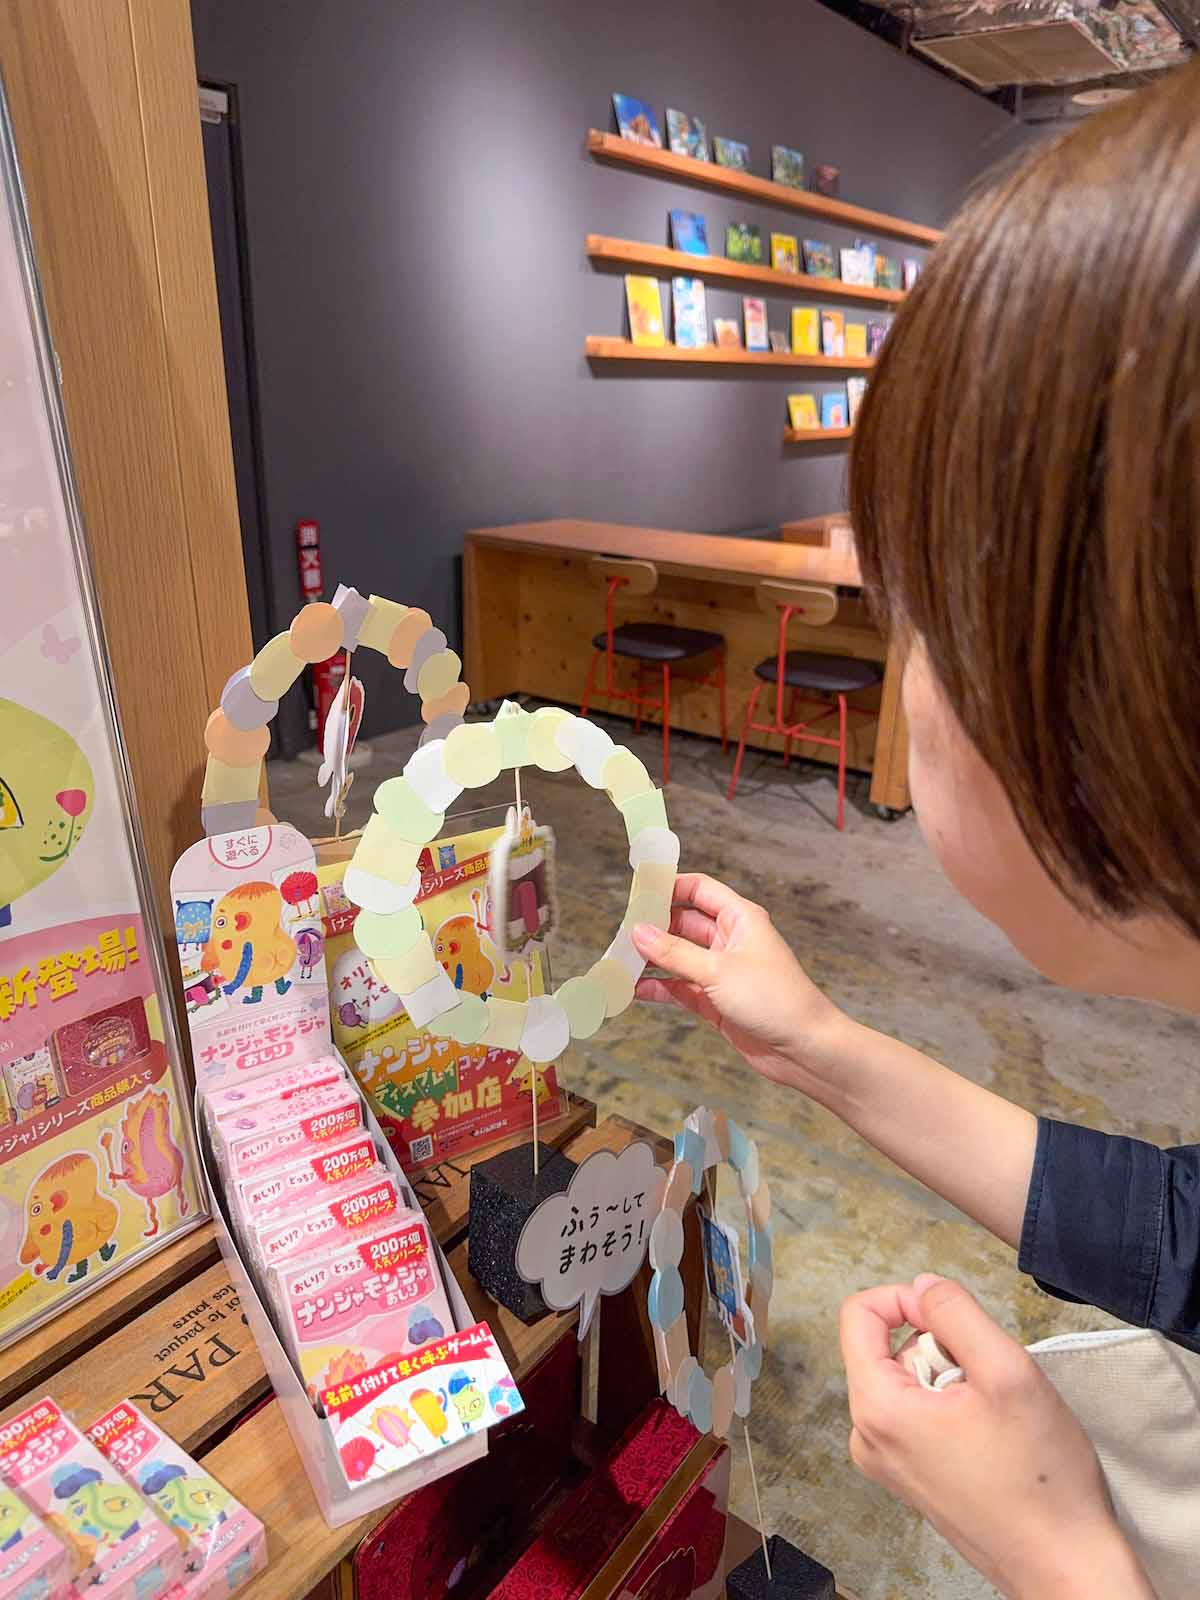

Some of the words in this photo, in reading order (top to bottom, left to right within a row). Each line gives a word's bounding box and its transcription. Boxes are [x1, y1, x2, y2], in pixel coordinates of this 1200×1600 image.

[224, 834, 259, 850] すぐに
[225, 847, 259, 862] 遊べる
[200, 1016, 326, 1064] ナンジャモンジャ
[244, 1041, 289, 1066] おしり
[358, 1033, 450, 1083] ナンジャ
[375, 1060, 456, 1103] ディスプレイ
[411, 1076, 502, 1131] 参加店
[322, 1146, 369, 1172] 200万個
[341, 1188, 390, 1217] 200万個
[369, 1230, 421, 1260] 200万個
[373, 1243, 425, 1272] 人気シリーズ
[560, 1219, 645, 1274] まわそう!
[293, 1270, 327, 1294] おしり?
[333, 1257, 363, 1276] どっち?
[212, 1284, 237, 1300] les
[296, 1263, 429, 1328] ナンジャモンジャ
[386, 1282, 418, 1308] おしり
[173, 1300, 212, 1329] jours
[208, 1310, 227, 1323] le
[153, 1320, 205, 1362] paquet
[325, 1328, 490, 1407] 名前を付けて早く呼ぶゲーム!
[0, 1406, 50, 1441] 00万個
